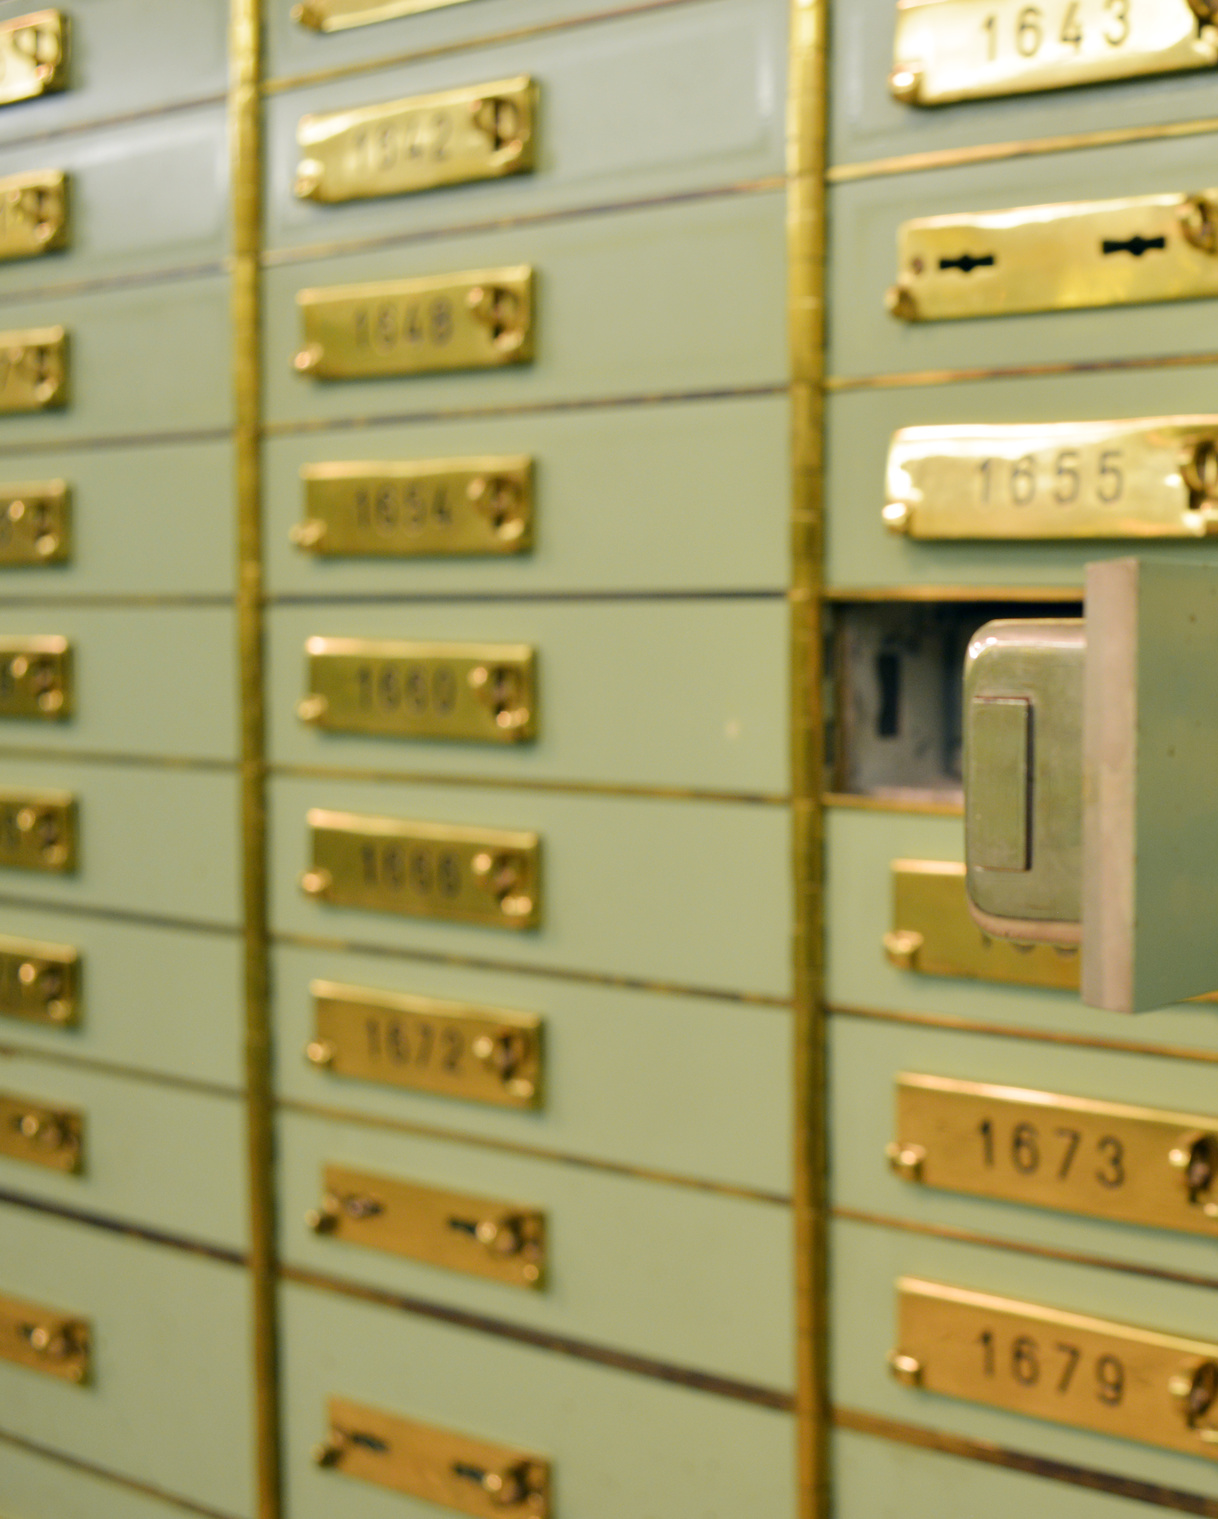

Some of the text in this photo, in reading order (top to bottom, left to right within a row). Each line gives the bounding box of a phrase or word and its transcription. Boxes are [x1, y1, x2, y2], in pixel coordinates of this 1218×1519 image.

[980, 0, 1131, 61] 1643
[976, 450, 1126, 507] 1655
[366, 1016, 465, 1075] 1672
[976, 1117, 1126, 1189] 1673
[977, 1329, 1126, 1406] 1679
